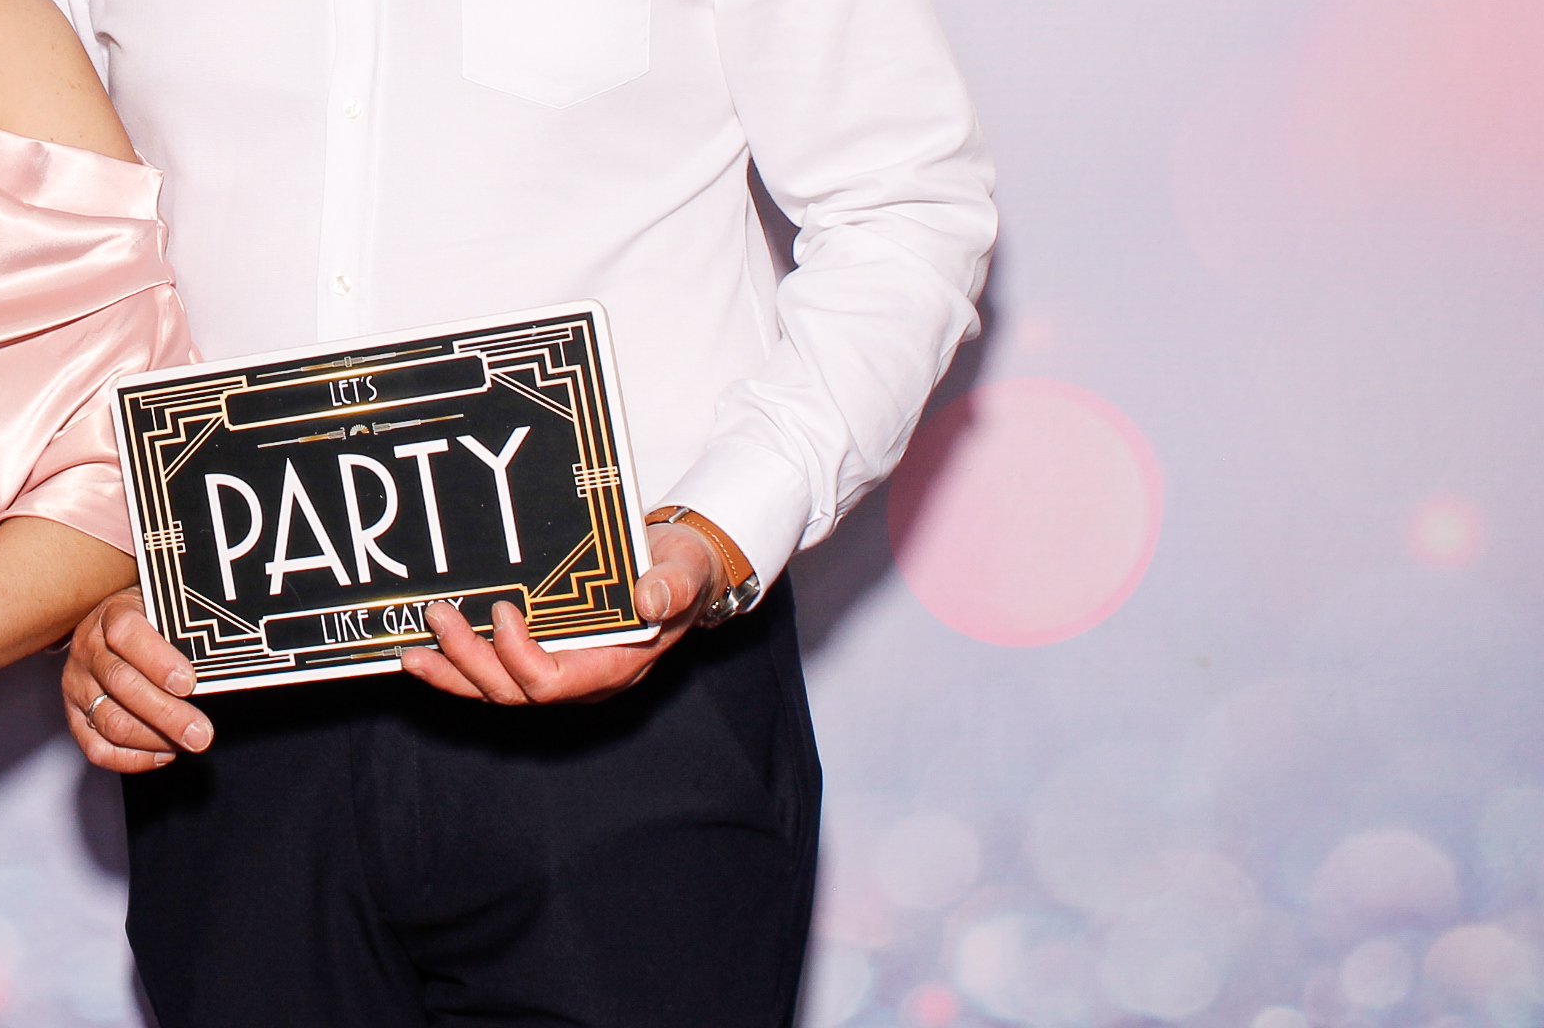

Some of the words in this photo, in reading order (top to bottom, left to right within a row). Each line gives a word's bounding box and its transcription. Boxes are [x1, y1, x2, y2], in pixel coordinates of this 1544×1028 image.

[329, 375, 378, 407] LET'S
[204, 425, 531, 601] PARTY
[320, 609, 373, 644] LIKE
[382, 597, 464, 635] GATY
